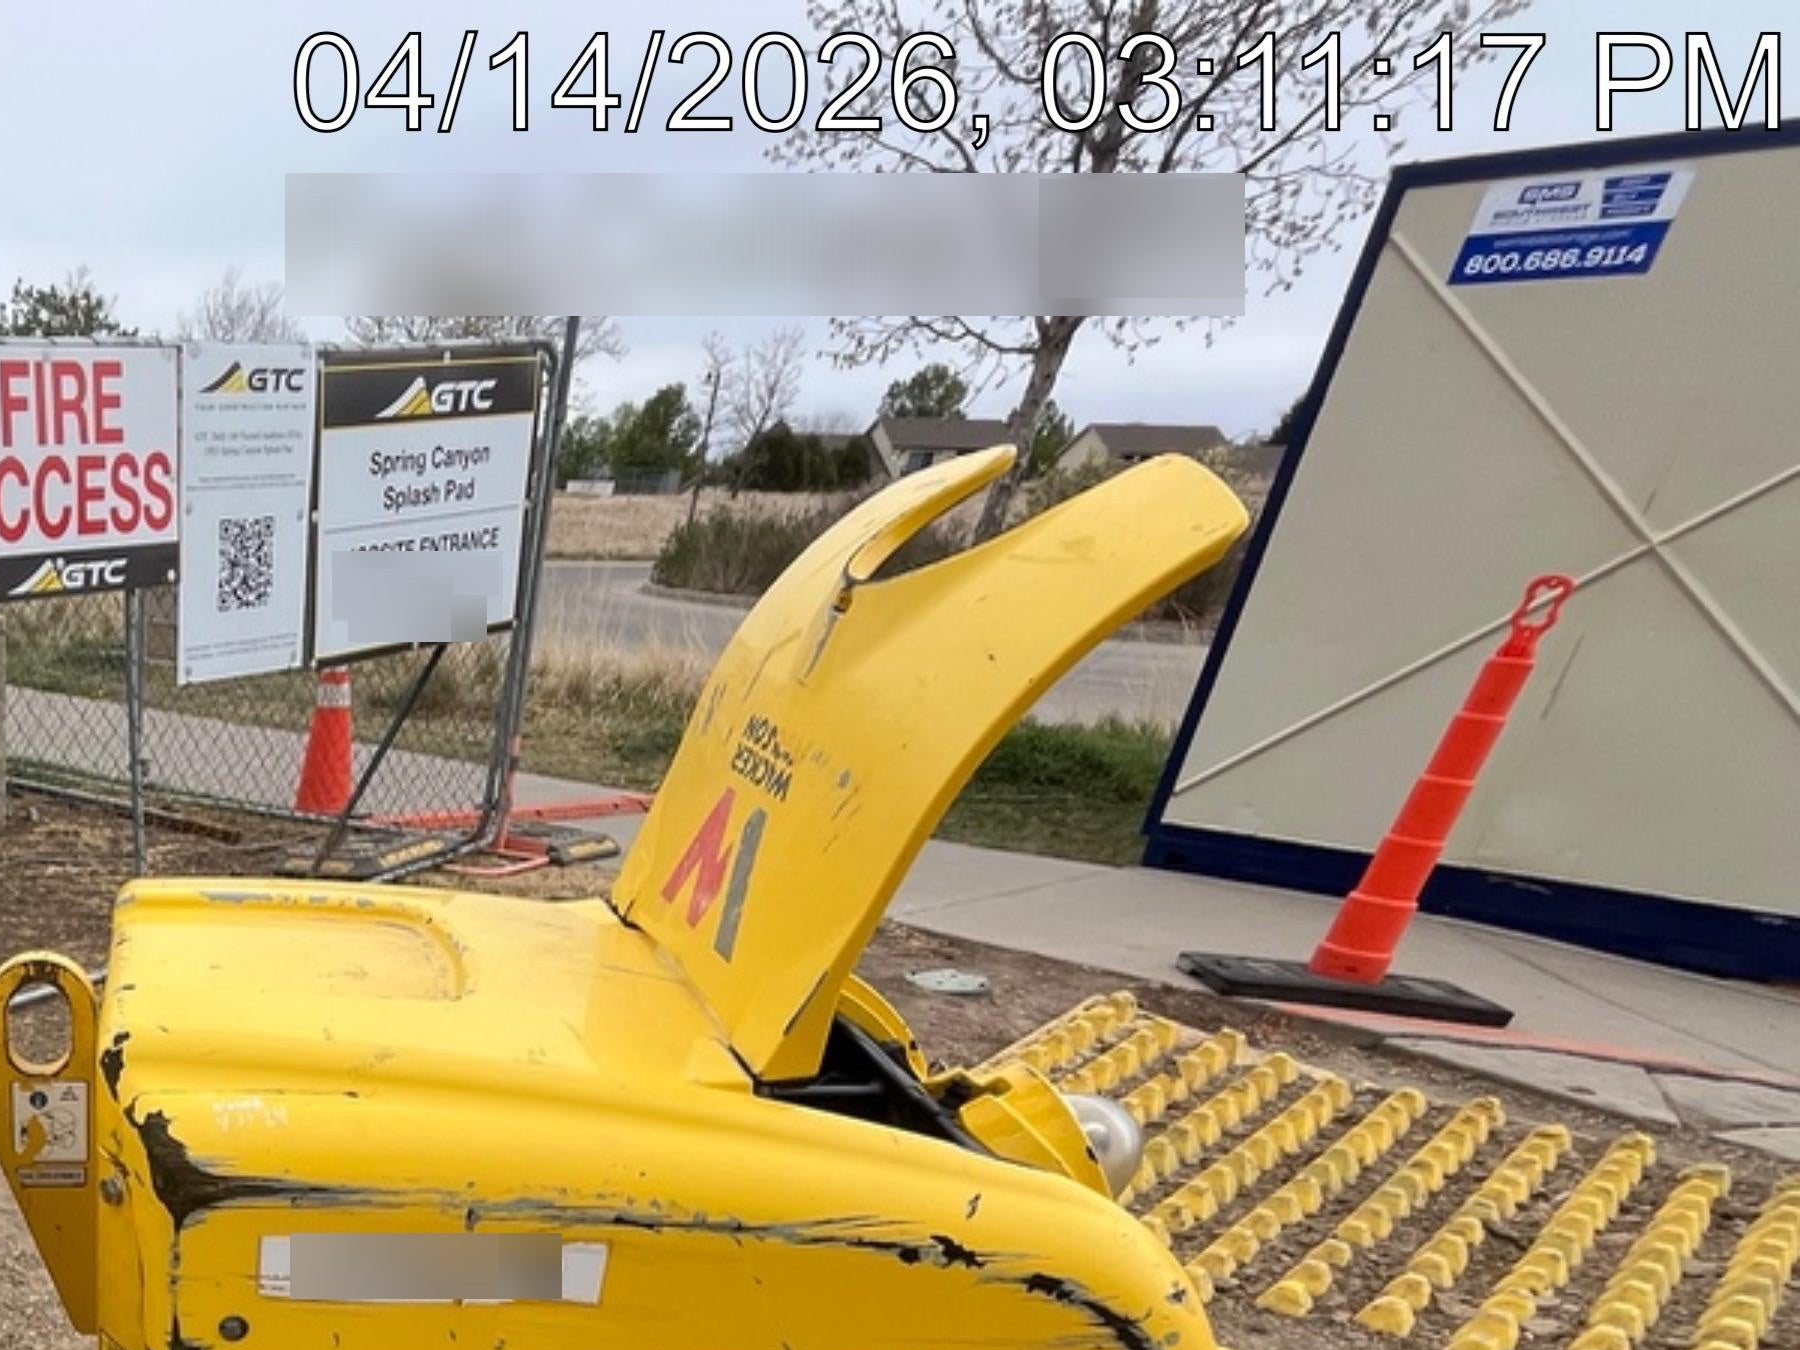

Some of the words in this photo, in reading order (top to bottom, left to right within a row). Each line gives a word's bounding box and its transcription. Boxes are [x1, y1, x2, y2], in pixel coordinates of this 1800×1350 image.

[247, 368, 306, 392] GTC
[430, 379, 498, 413] GTC
[0, 359, 124, 447] FIRE
[369, 449, 427, 477] Spring
[431, 445, 490, 470] Canyon
[383, 484, 440, 512] Splash
[444, 478, 475, 502] Pad
[62, 558, 128, 588] GTC
